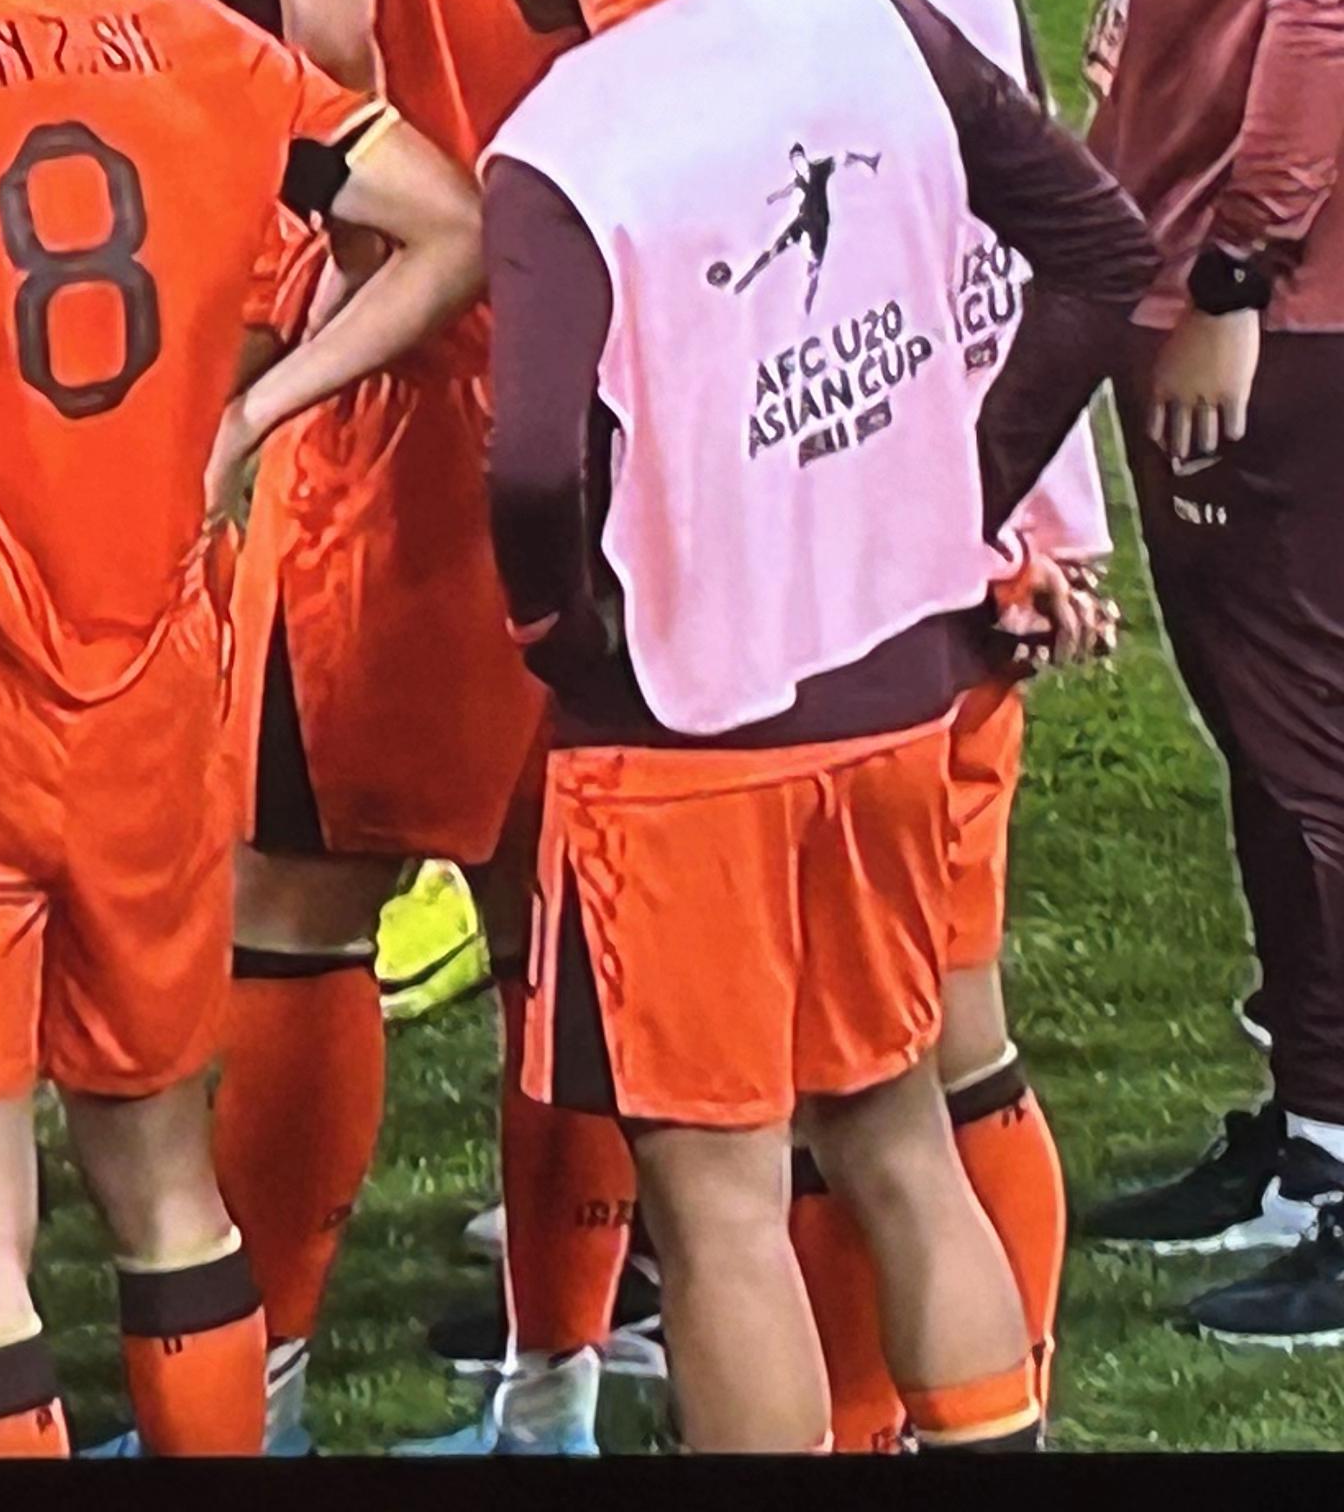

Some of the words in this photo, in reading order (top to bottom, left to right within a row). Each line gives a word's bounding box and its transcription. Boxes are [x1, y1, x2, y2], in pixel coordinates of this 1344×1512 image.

[747, 369, 854, 460] ASIAN
[857, 335, 933, 398] CUP
[755, 336, 827, 408] AFC
[831, 299, 903, 363] U20
